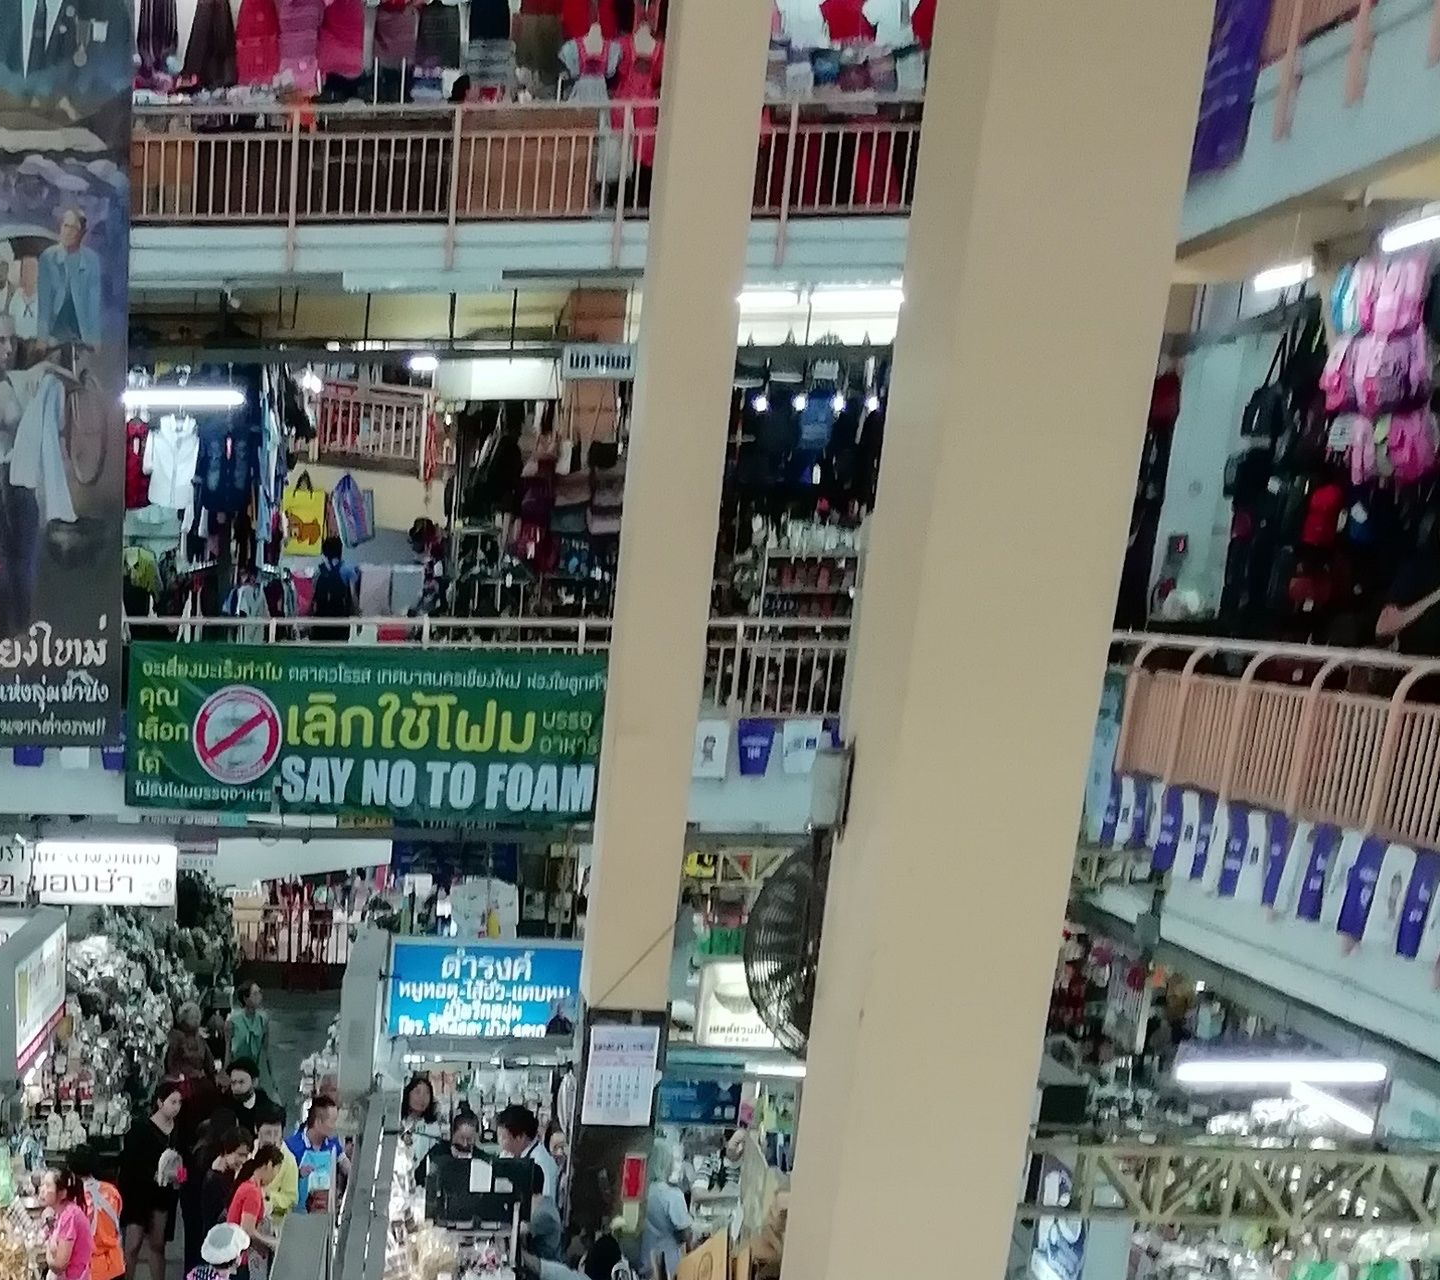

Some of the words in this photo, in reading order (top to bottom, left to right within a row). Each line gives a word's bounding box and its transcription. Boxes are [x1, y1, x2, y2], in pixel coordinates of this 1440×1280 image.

[139, 685, 180, 714] คุณ
[137, 715, 190, 743] เลือก
[287, 690, 536, 753] เลิกใช้โฟม
[137, 748, 161, 775] ได้
[281, 754, 355, 805] SAY
[361, 757, 417, 809] NO
[426, 760, 477, 810] TO
[485, 762, 596, 813] FOAM
